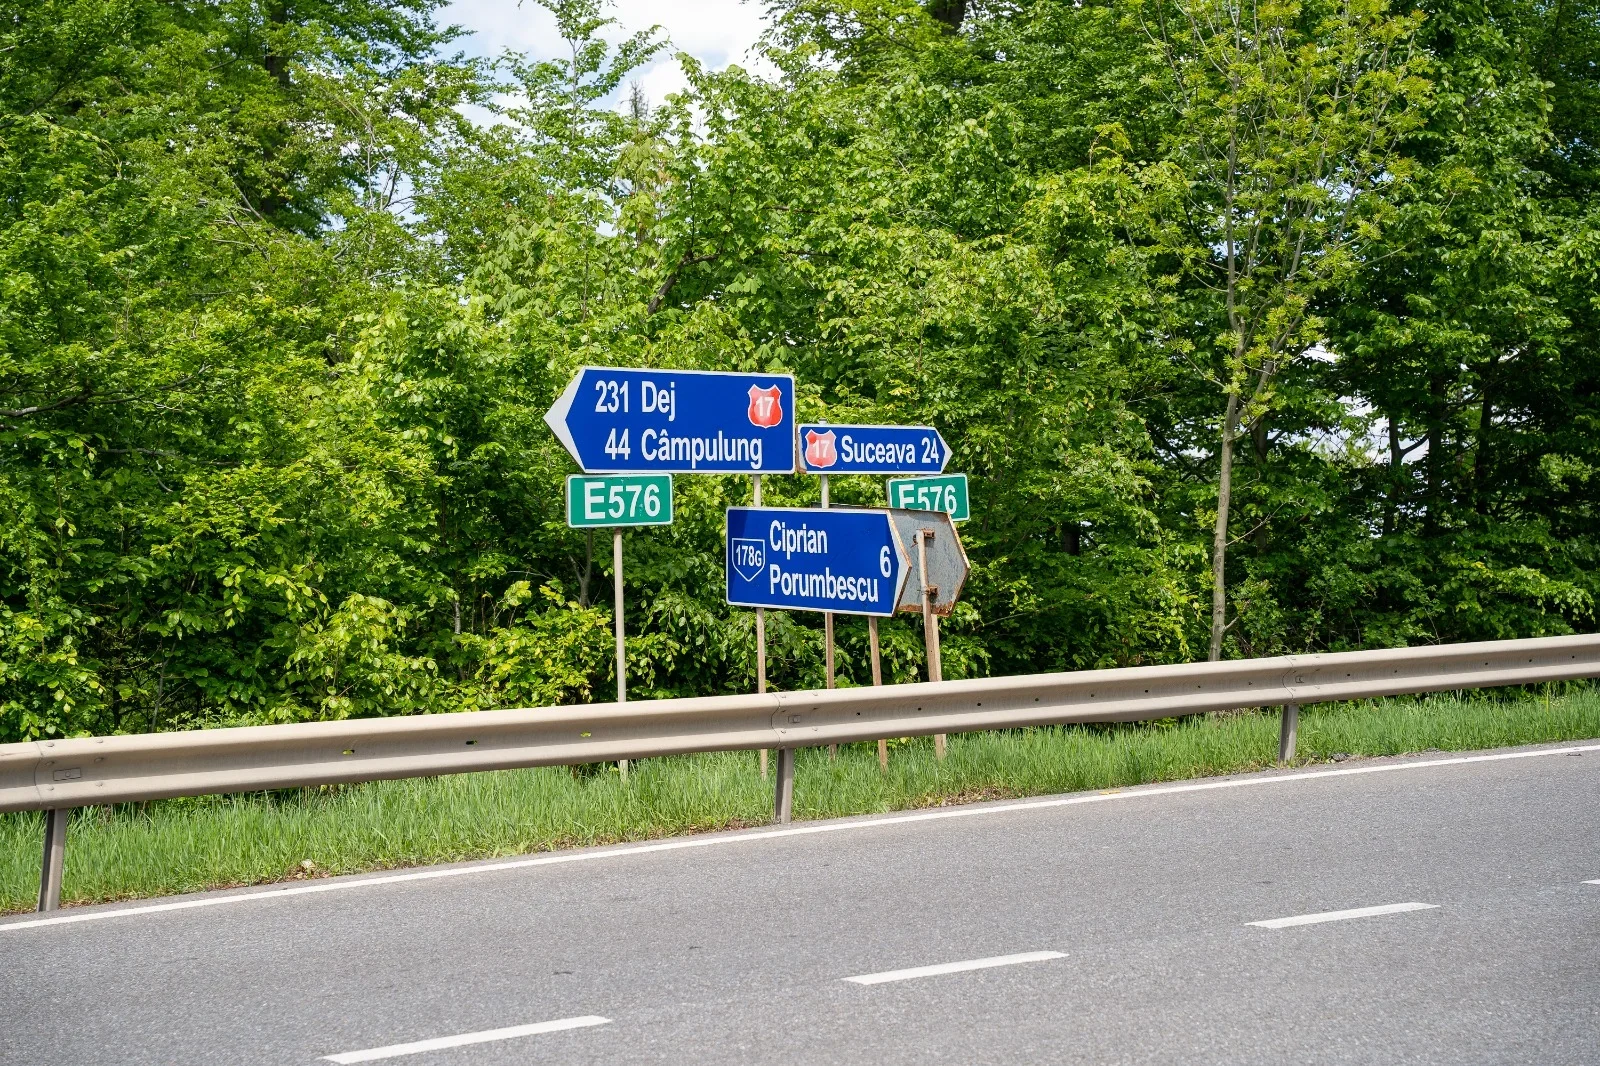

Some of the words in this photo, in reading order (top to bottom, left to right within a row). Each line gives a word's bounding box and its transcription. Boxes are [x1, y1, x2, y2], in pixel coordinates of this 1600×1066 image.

[595, 380, 629, 413] 231
[641, 381, 676, 421] Dej
[755, 396, 775, 417] 17
[604, 428, 631, 460] 44
[641, 428, 763, 469] Câmpulung
[812, 439, 830, 459] 17
[841, 435, 916, 464] Suceava
[921, 437, 939, 464] 24
[584, 481, 661, 519] E576
[898, 484, 957, 514] E576
[735, 544, 762, 567] 178G
[769, 519, 828, 560] Ciprian
[879, 546, 892, 578] 6
[769, 564, 879, 603] Porumbescu
